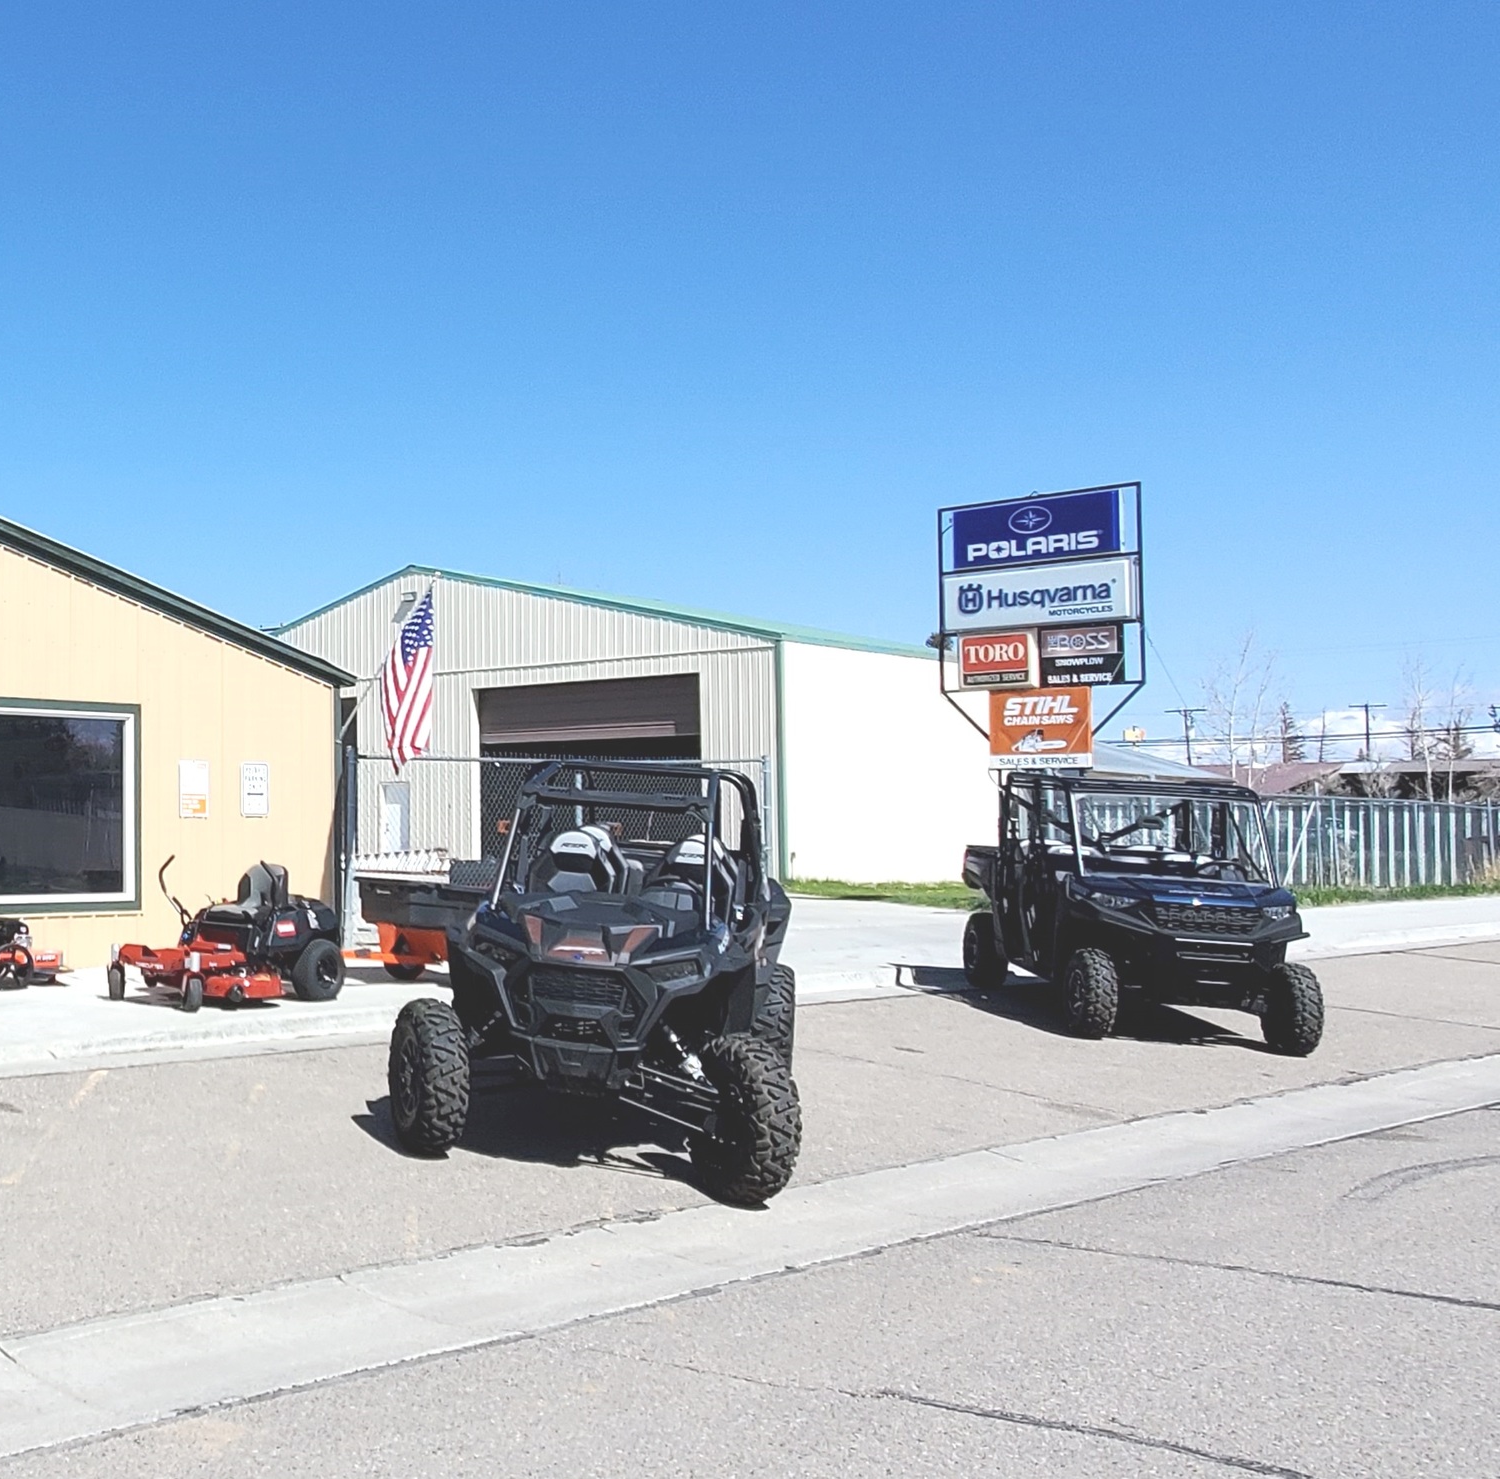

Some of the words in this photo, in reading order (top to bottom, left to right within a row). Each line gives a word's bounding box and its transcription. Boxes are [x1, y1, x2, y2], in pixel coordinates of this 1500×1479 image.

[967, 530, 1099, 562] POLARIS
[987, 582, 1111, 610] Husqvarna
[1048, 605, 1114, 616] MOTORCYCLES
[1057, 632, 1110, 651] BOSS
[965, 643, 1025, 664] TORO
[1055, 657, 1104, 667] SNOWPLOW
[1002, 673, 1026, 681] SERVICE
[1047, 674, 1070, 684] SALES
[1072, 674, 1079, 683] &
[1080, 672, 1113, 683] SERVICE
[1003, 695, 1079, 716] STIHL
[1004, 715, 1040, 726] CHAIN
[1041, 714, 1074, 724] SAWS
[999, 757, 1029, 766] SALES
[1031, 757, 1037, 765] &
[1039, 756, 1079, 765] SERVICE
